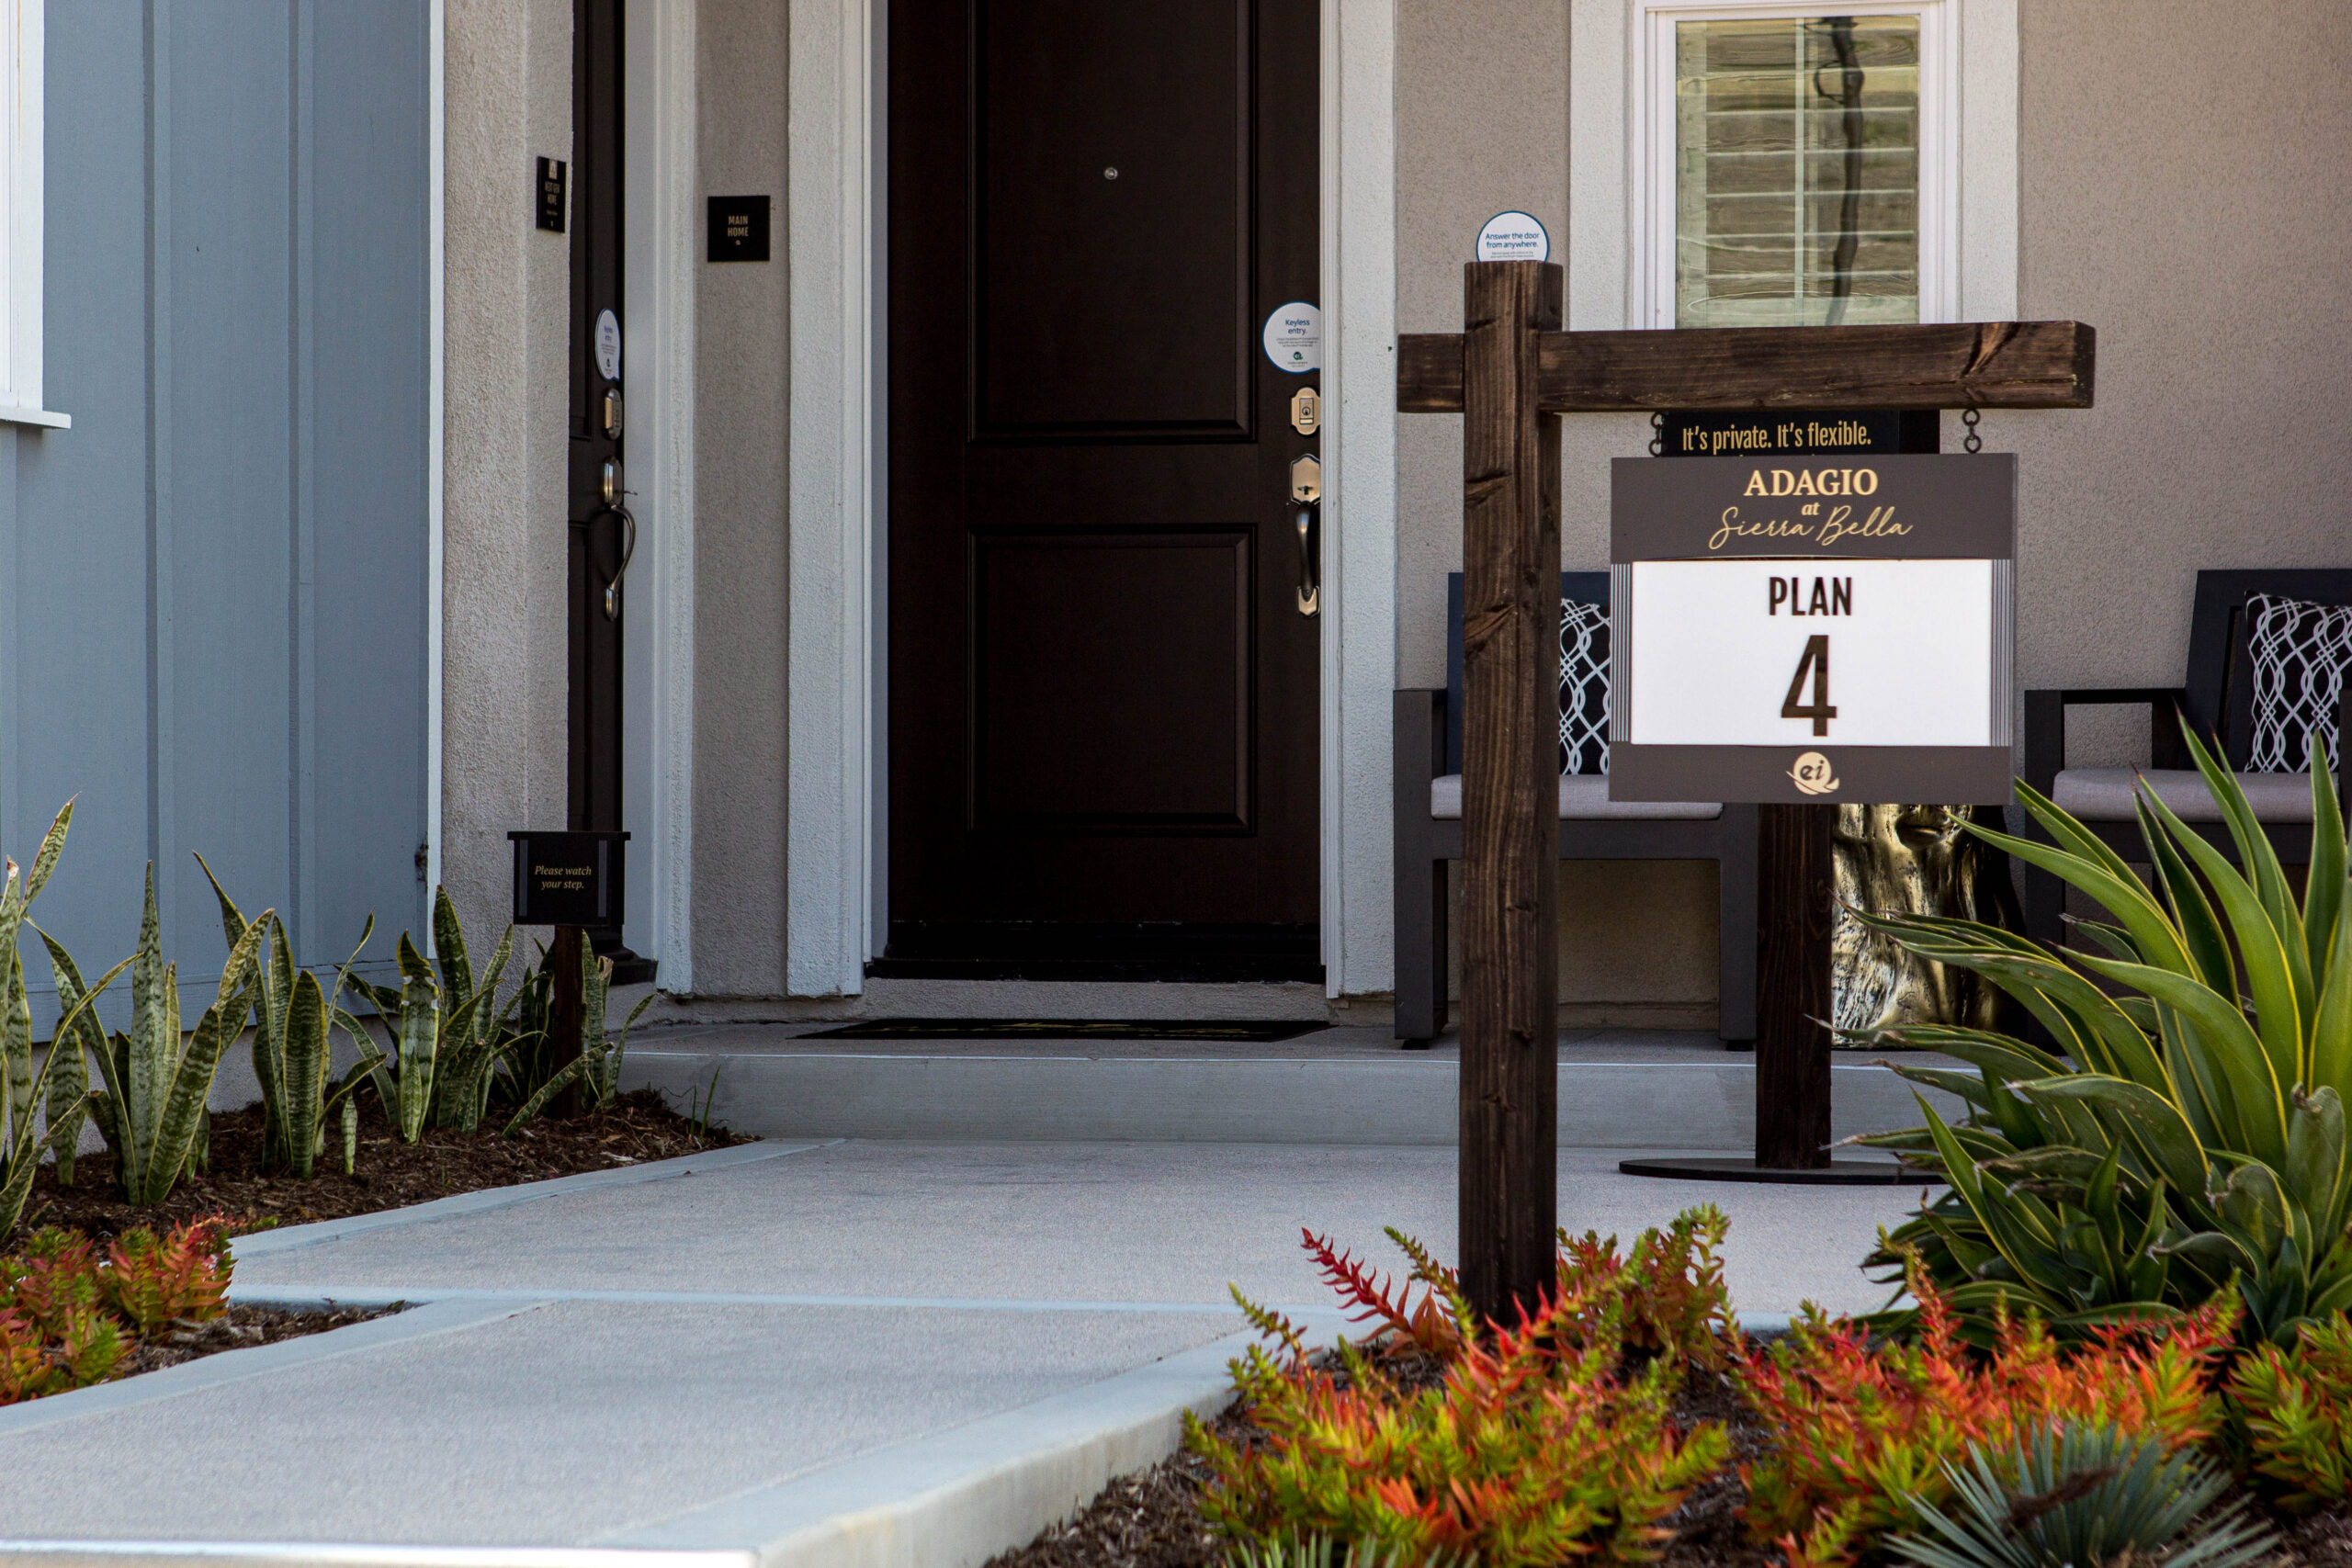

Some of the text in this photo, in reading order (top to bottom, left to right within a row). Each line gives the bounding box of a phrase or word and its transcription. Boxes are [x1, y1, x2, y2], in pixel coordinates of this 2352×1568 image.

[728, 214, 749, 225] MAIN
[727, 226, 750, 237] HOME
[1524, 231, 1540, 240] door
[1487, 241, 1538, 250] from anywhere.
[1285, 319, 1310, 327] Keyless
[1713, 424, 1772, 455] private.
[1807, 421, 1871, 446] flexible.
[1743, 468, 1879, 497] ADAGIO
[1801, 502, 1821, 516] at
[1708, 505, 1914, 550] Sierra Bella
[1769, 576, 1852, 616] PLAN
[1781, 634, 1838, 737] 4
[1799, 759, 1826, 781] ei
[535, 865, 593, 875] Please watch
[541, 880, 584, 891] your step.
